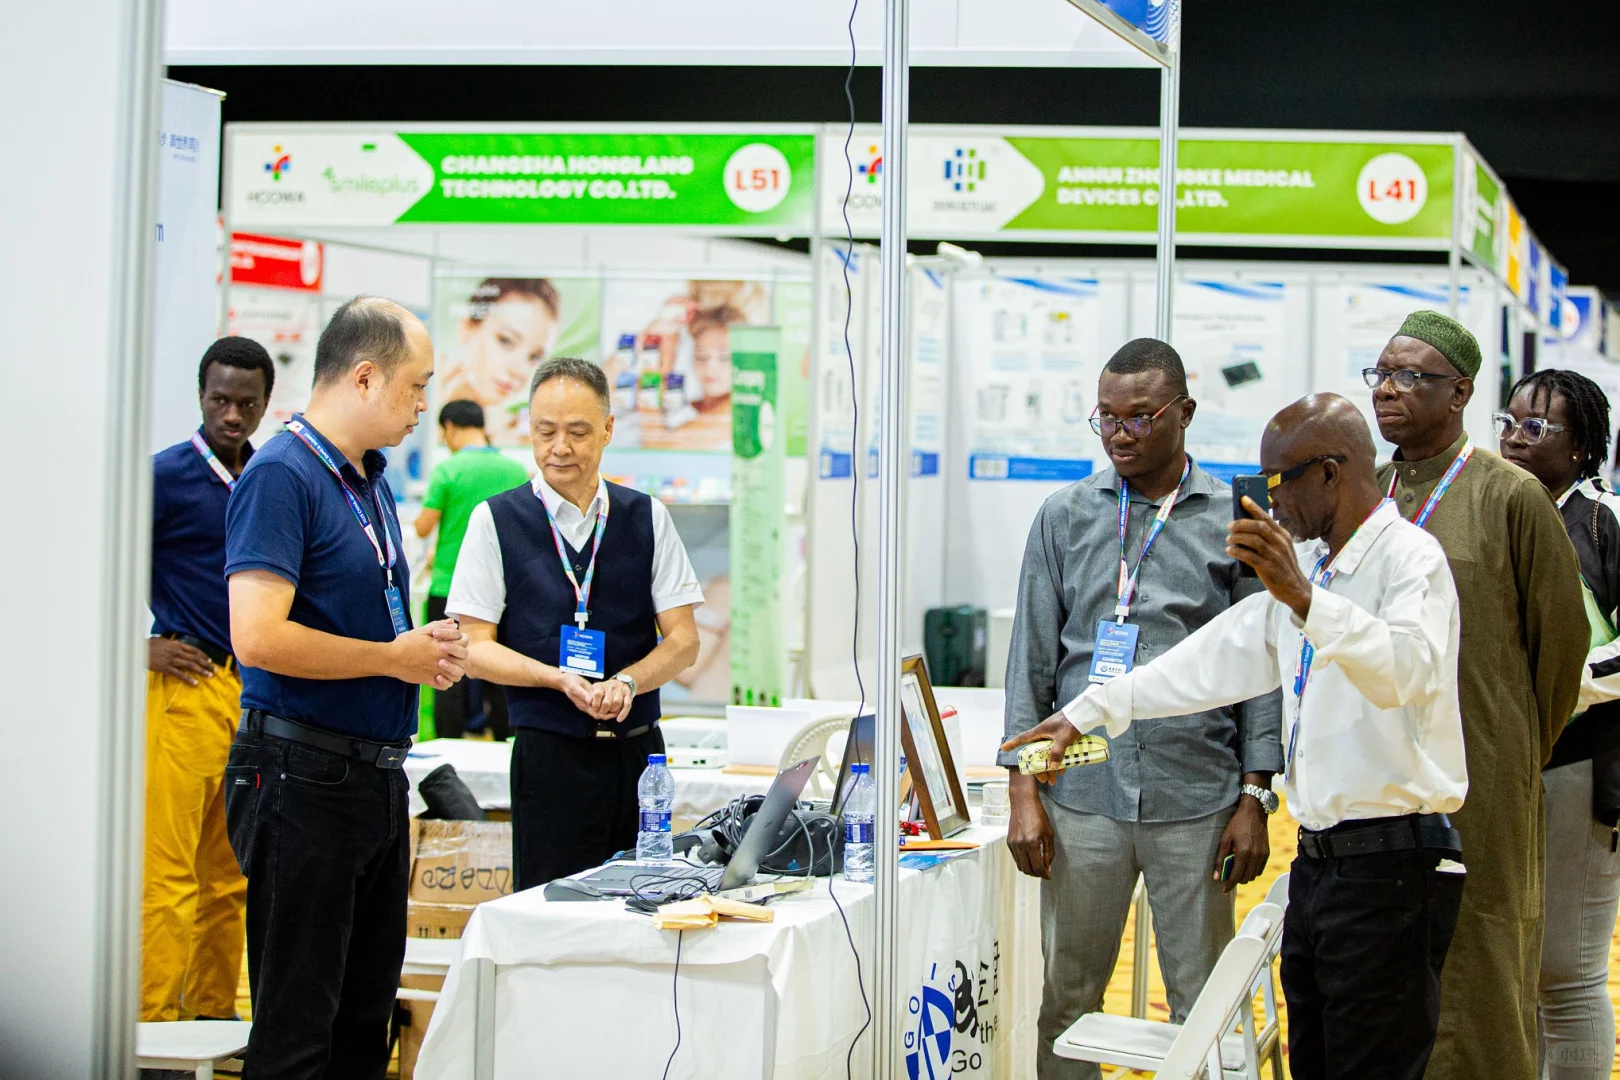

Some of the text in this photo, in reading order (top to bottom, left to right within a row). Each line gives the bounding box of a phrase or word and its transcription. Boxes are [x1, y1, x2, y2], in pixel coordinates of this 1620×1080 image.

[441, 155, 565, 175] CHANGSHA
[736, 167, 780, 191] L51
[1057, 166, 1123, 184] ANHUI
[1224, 168, 1315, 188] MEDICAL
[440, 179, 587, 198] TECHNOLOGY
[1056, 188, 1140, 205] DEVICES
[1369, 180, 1416, 201] L41
[951, 1049, 982, 1073] Go
